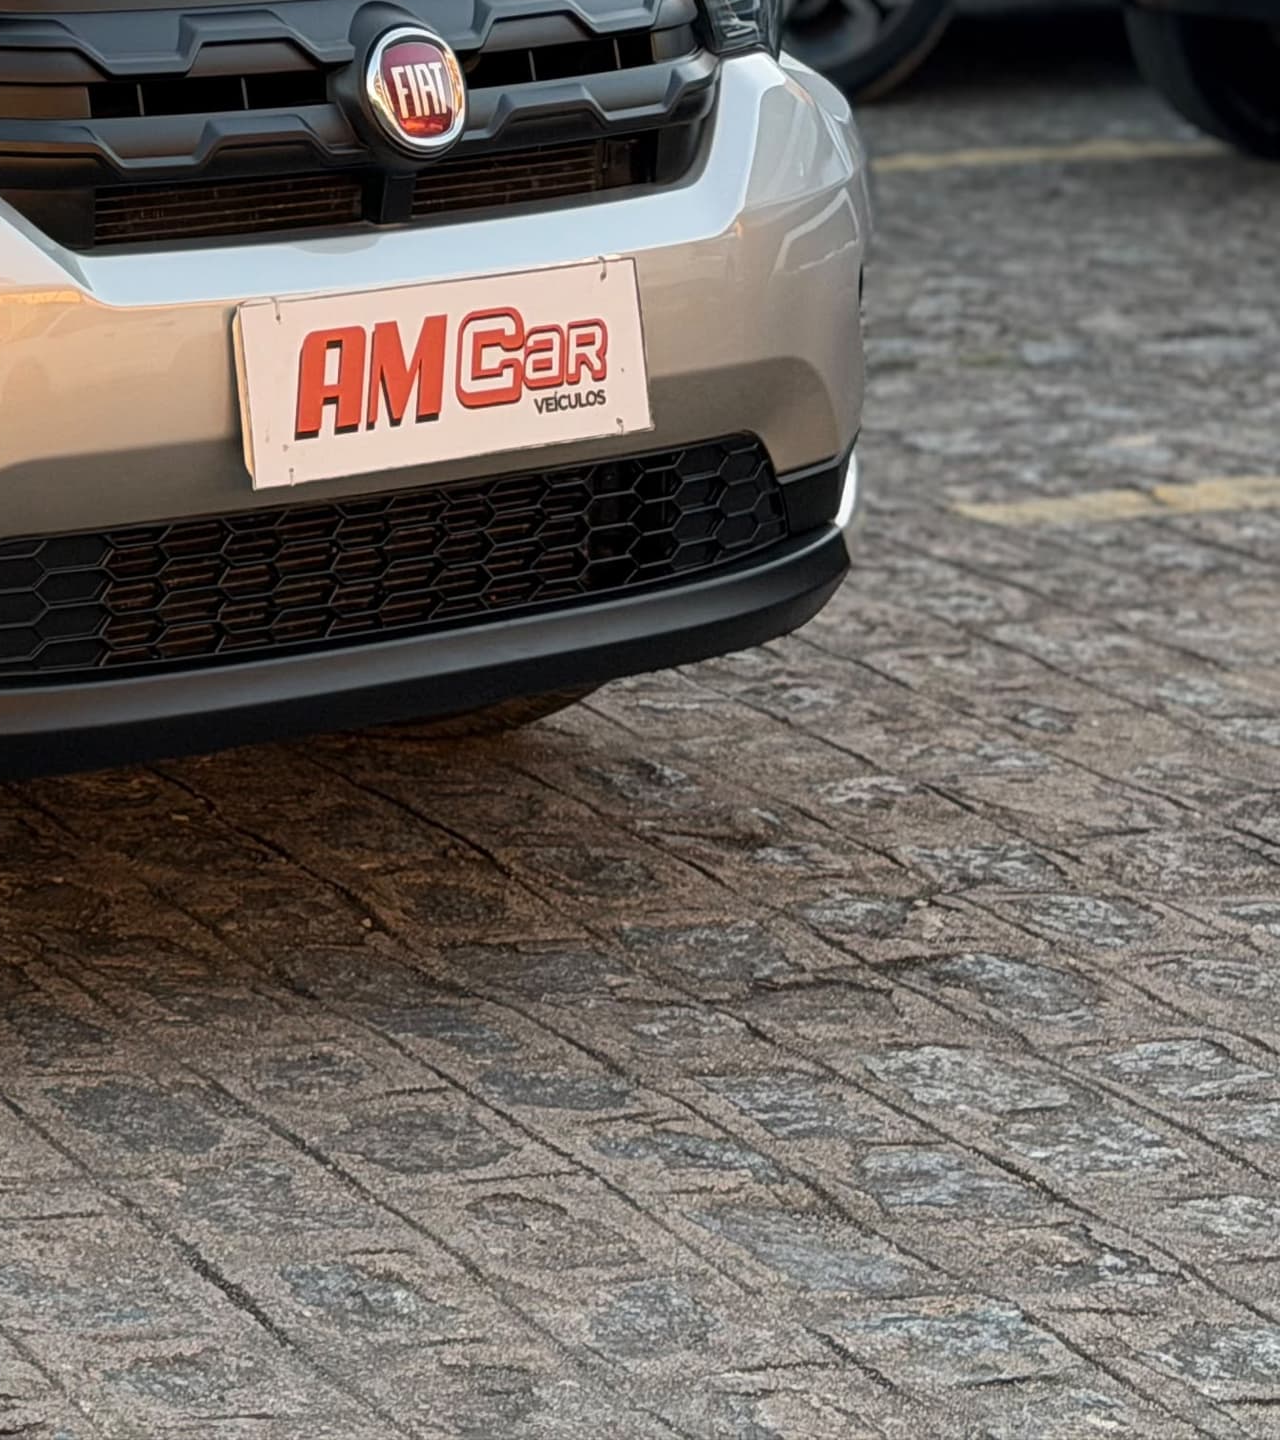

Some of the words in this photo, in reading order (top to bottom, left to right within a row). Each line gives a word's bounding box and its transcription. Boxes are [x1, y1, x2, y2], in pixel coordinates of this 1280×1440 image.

[390, 61, 448, 119] FIAT
[294, 313, 448, 441] AM
[533, 389, 607, 415] VEÍCULOS
